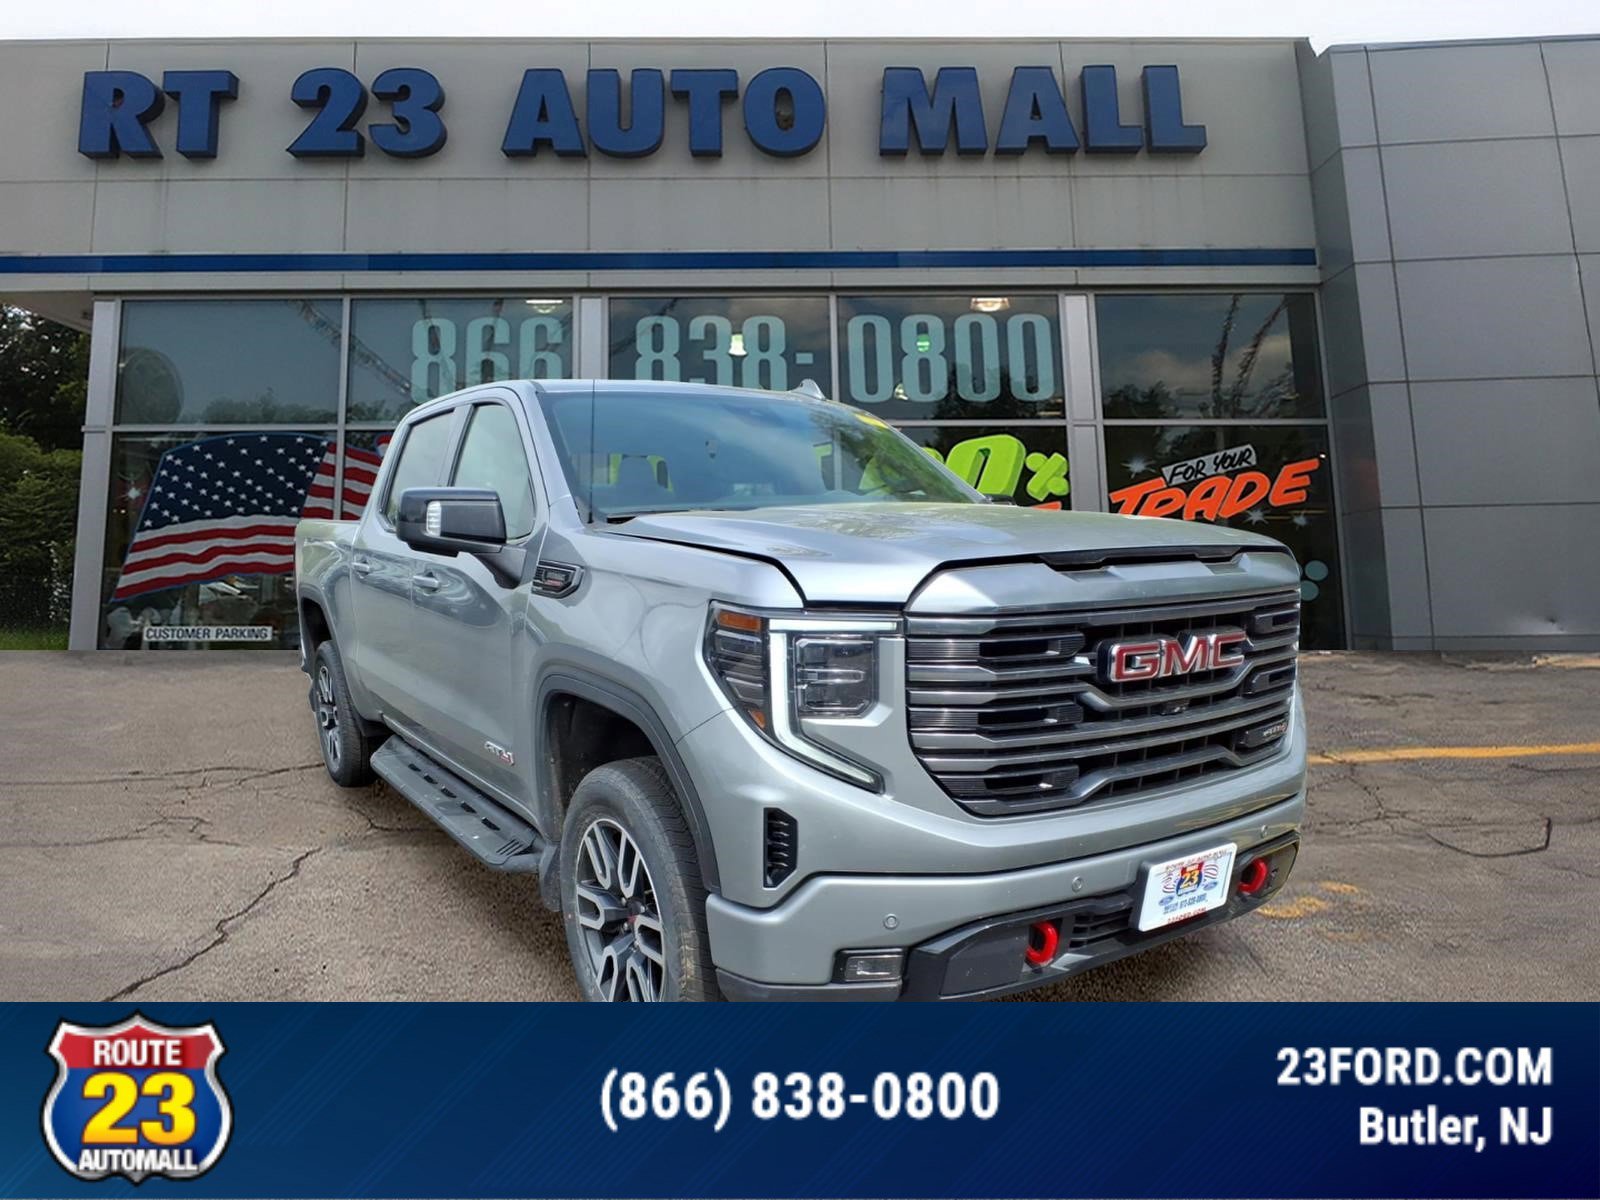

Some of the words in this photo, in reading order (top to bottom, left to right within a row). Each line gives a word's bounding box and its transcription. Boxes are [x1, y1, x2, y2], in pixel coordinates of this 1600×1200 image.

[78, 70, 239, 159] RT
[287, 68, 447, 158] 23
[502, 67, 826, 158] AUTO
[879, 65, 1207, 155] MALL
[411, 317, 563, 402] 866
[1109, 458, 1320, 522] TRADE
[1168, 460, 1207, 484] FOR
[1213, 448, 1253, 472] YOUR
[146, 627, 211, 639] CUSTOMER
[215, 627, 269, 639] PARKING
[1110, 630, 1252, 682] GMC
[1179, 869, 1200, 889] 23
